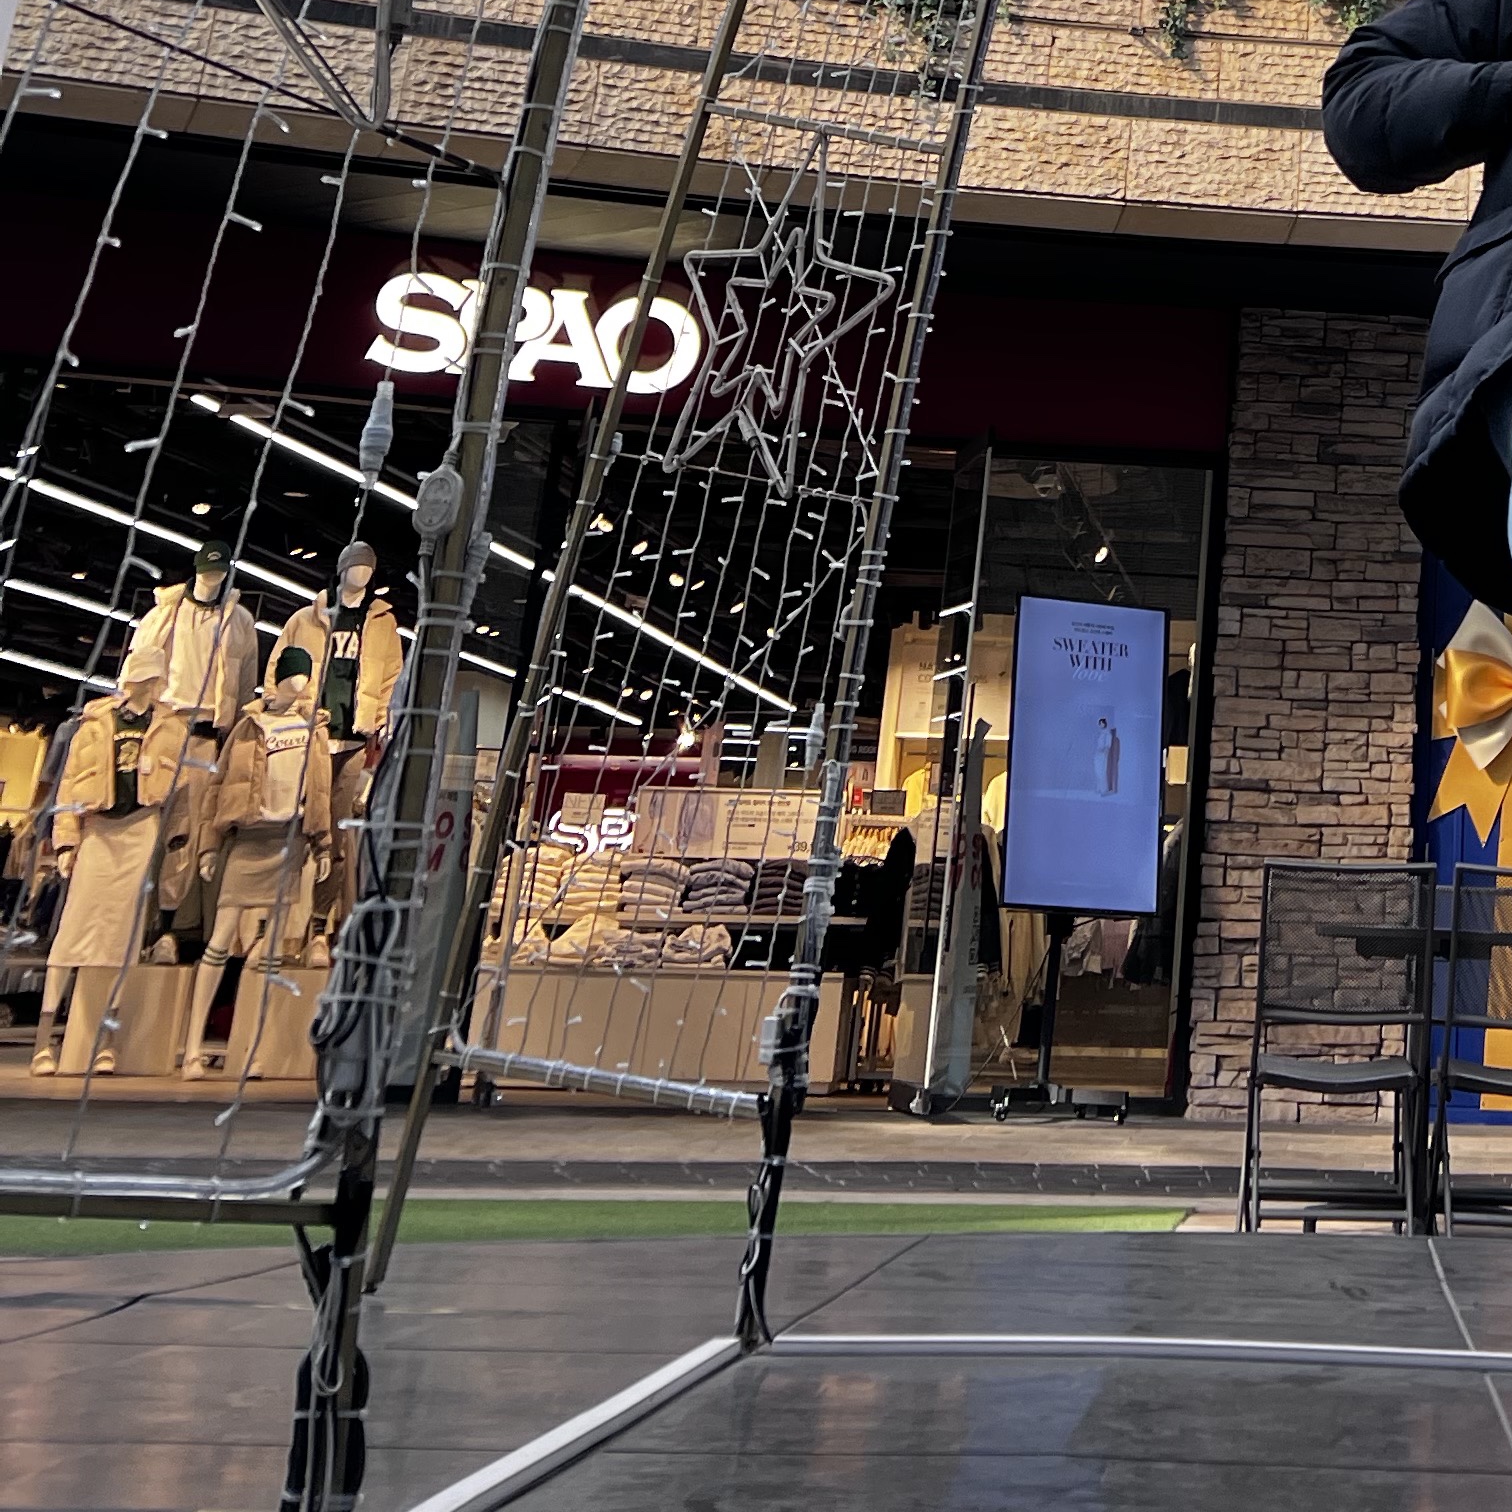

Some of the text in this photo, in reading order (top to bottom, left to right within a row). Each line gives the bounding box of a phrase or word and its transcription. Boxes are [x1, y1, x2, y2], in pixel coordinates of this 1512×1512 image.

[365, 272, 700, 394] SPAO
[1053, 637, 1129, 658] SWEATER
[1069, 653, 1112, 672] WITH
